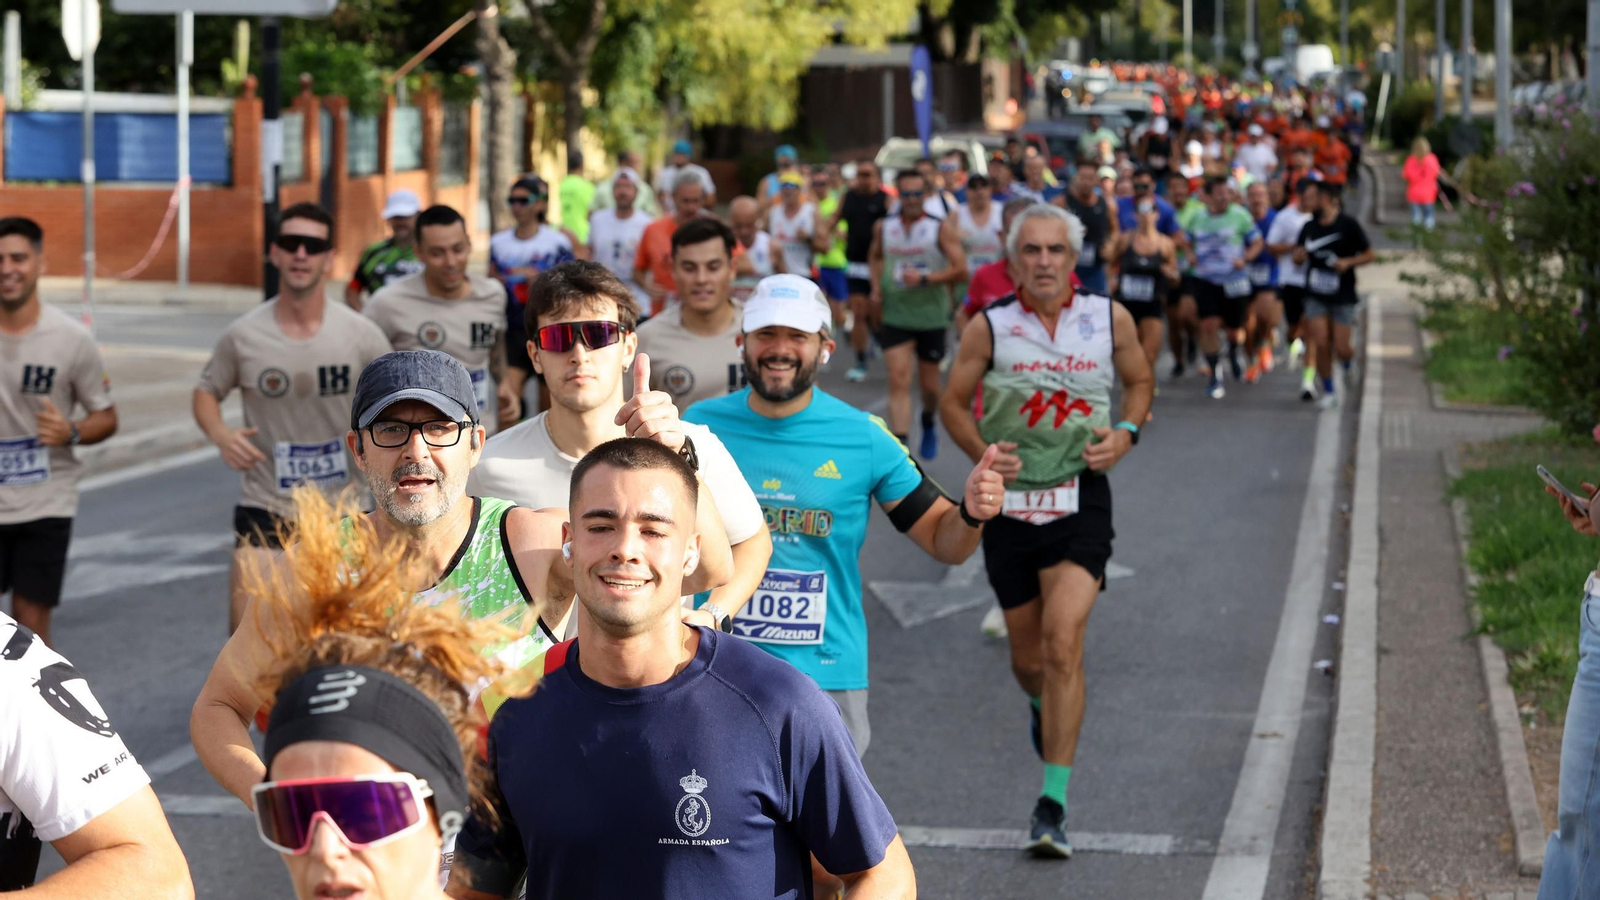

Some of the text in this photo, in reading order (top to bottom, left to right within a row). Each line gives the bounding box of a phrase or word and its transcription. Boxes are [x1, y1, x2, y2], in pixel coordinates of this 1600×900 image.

[23, 364, 56, 386] IX
[319, 365, 349, 389] IX
[288, 457, 334, 474] 1063
[1024, 490, 1055, 507] 171
[747, 594, 809, 619] 1082
[81, 763, 111, 784] WE
[657, 837, 730, 846] ARMADA ESPAÑOLA
